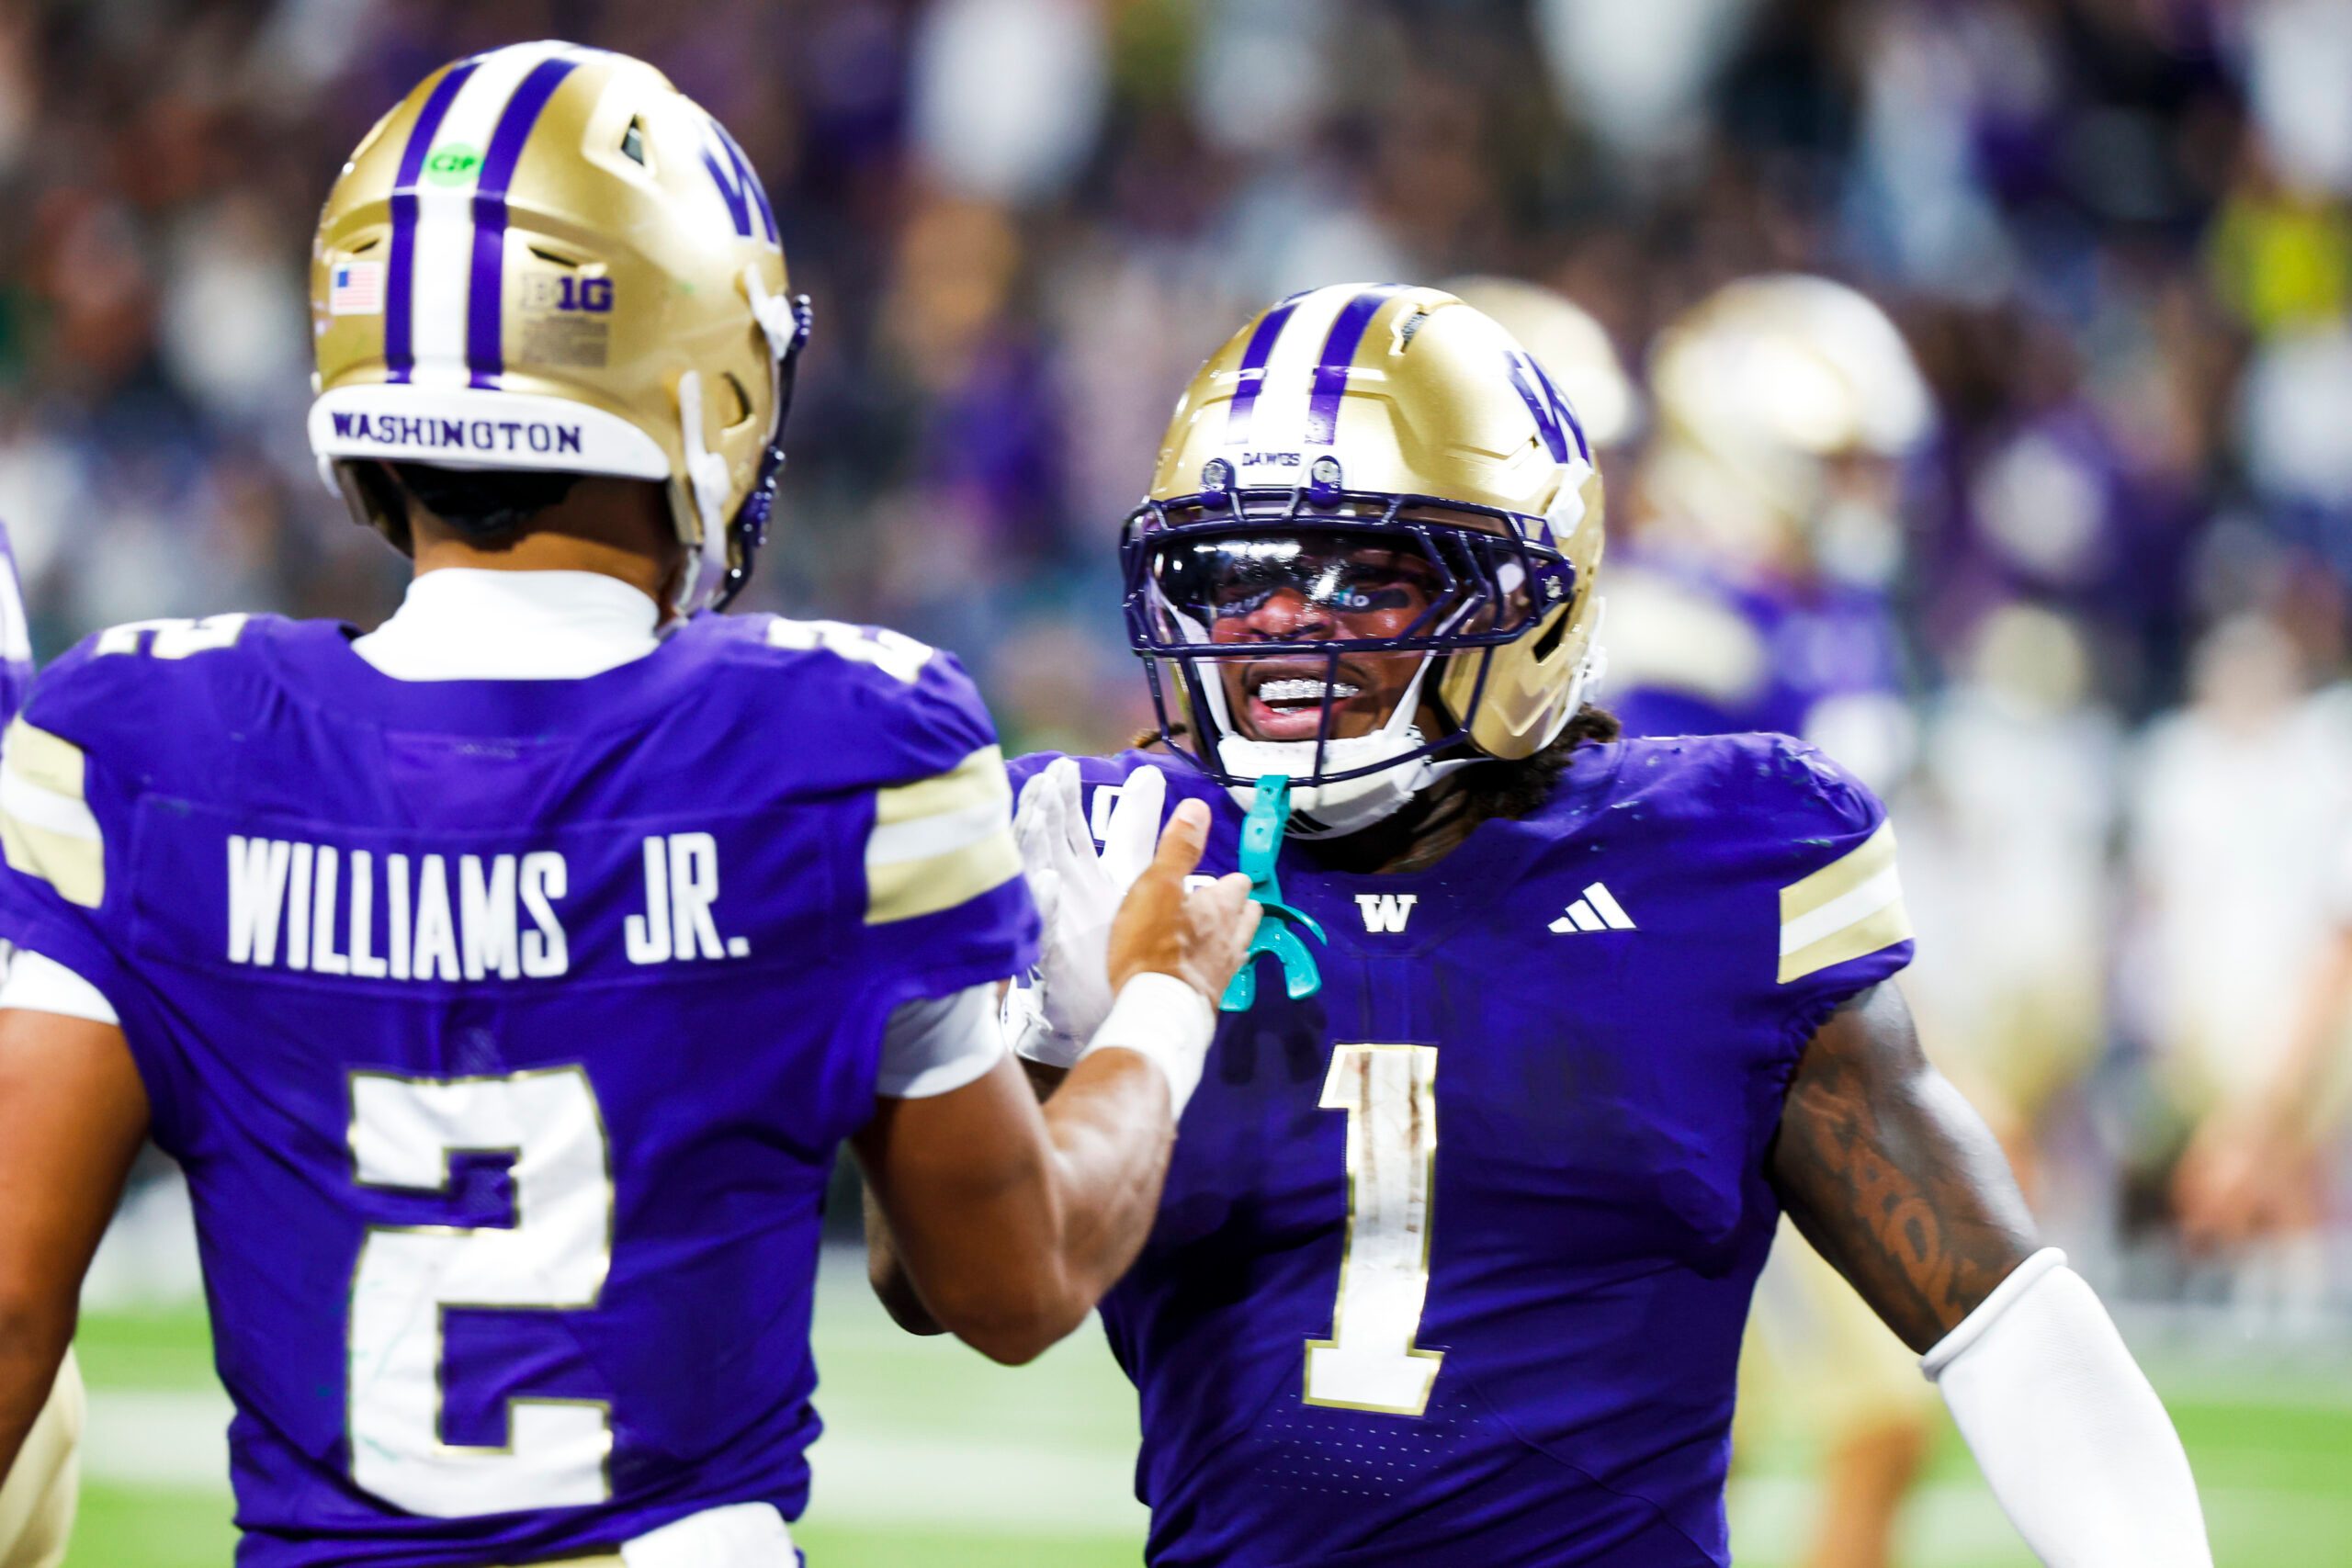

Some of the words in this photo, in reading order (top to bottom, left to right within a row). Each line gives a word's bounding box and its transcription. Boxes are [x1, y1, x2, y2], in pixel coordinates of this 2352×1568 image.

[331, 412, 582, 454] WASHINGTON
[227, 834, 569, 981] WILLIAMS
[624, 831, 751, 965] JR.
[1354, 894, 1418, 933] W
[346, 1064, 615, 1519] 2
[1302, 1043, 1445, 1417] 1
